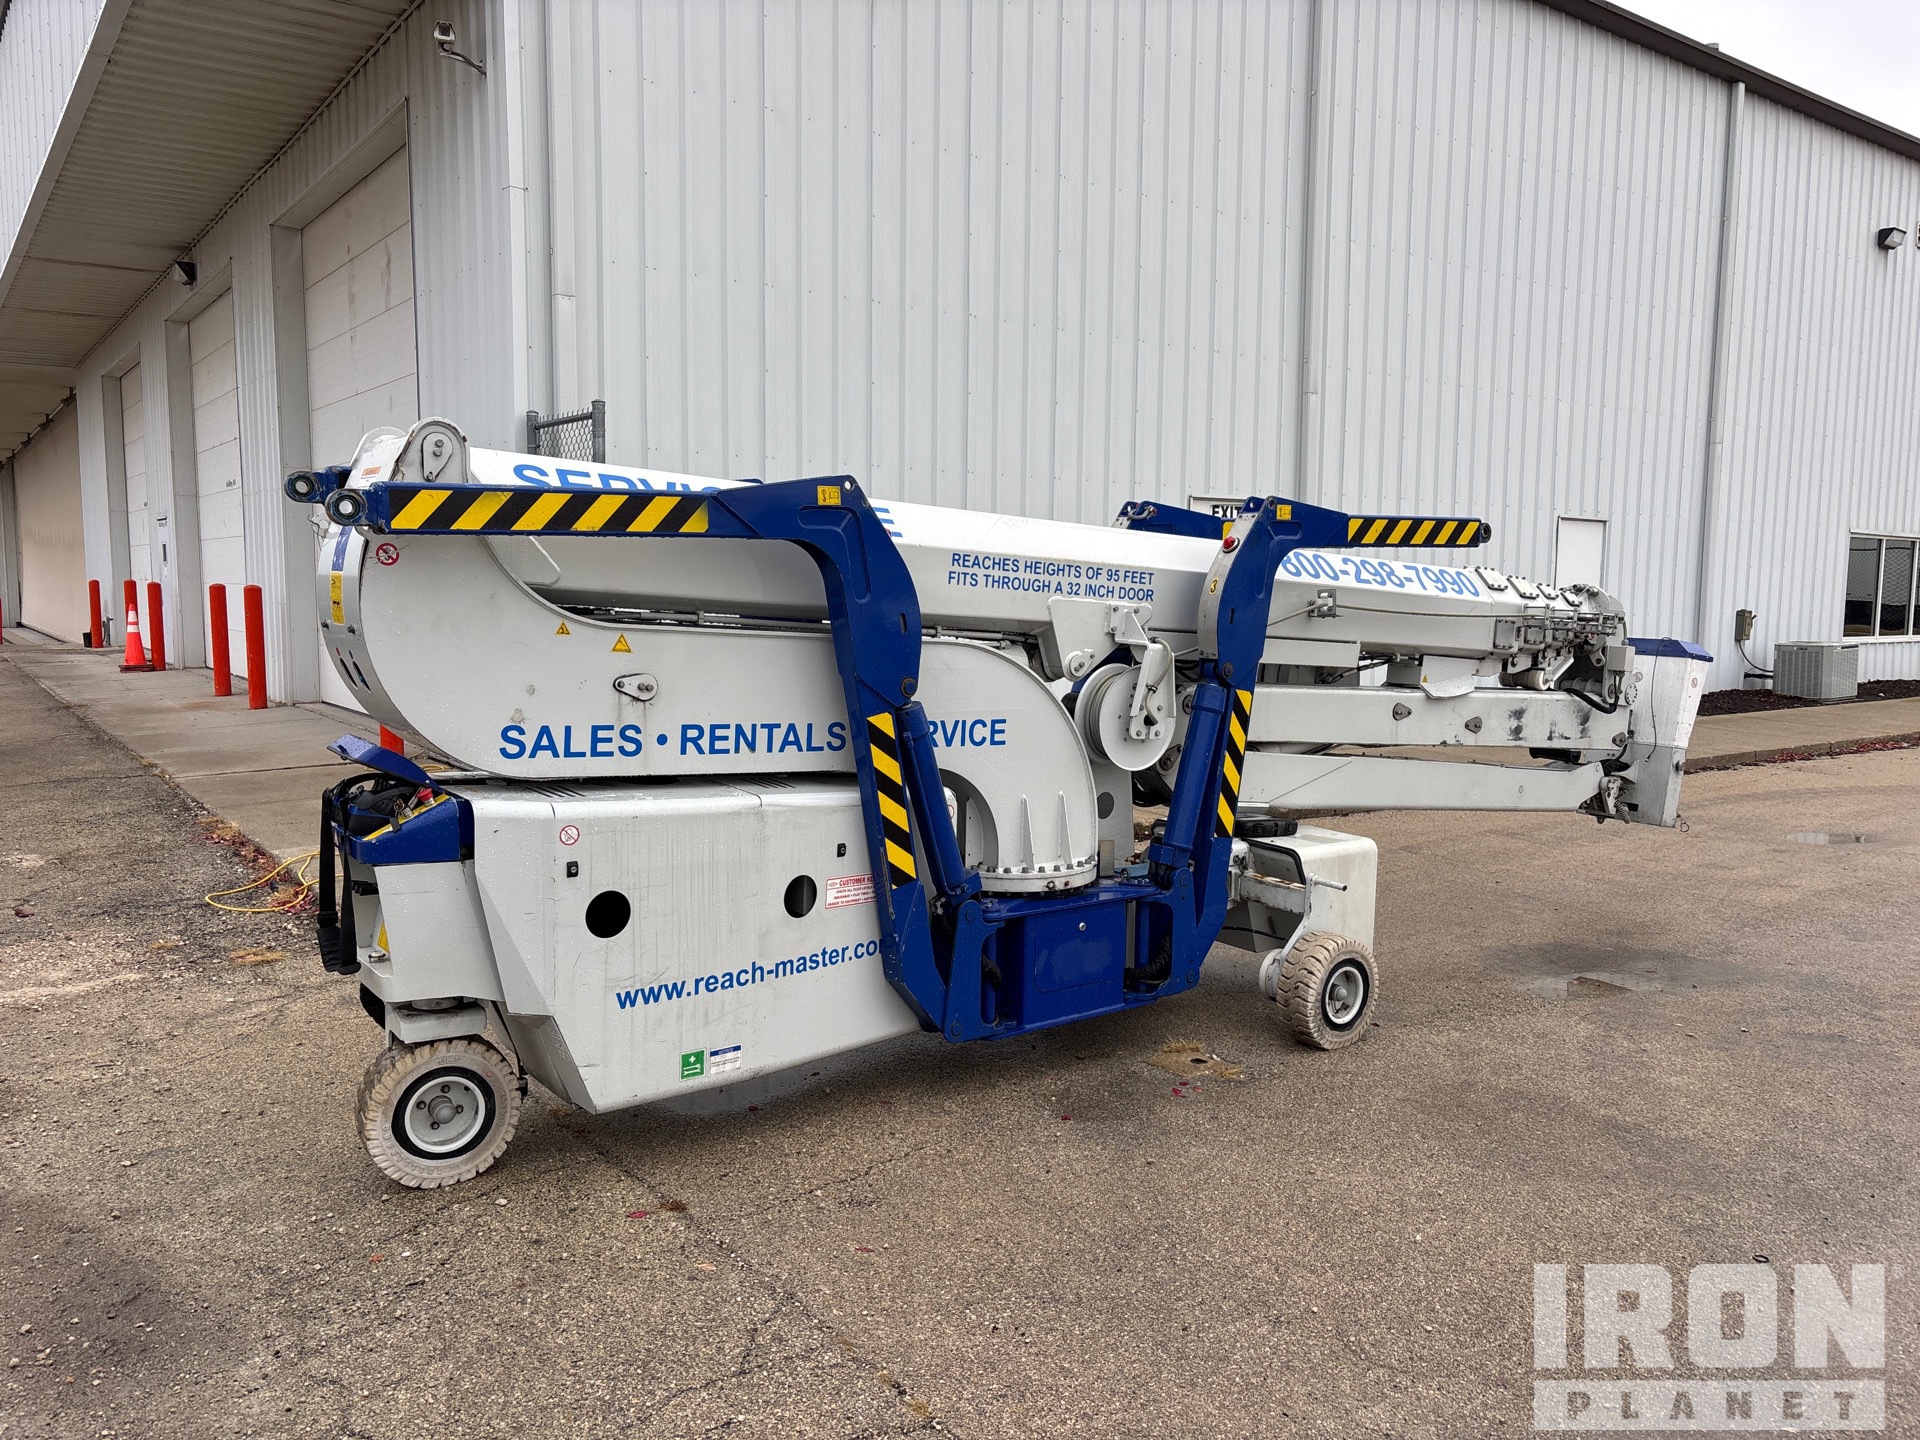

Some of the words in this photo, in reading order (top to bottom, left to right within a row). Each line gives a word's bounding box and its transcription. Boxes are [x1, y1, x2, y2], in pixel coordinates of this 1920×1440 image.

[952, 553, 1019, 573] REACHES
[1024, 560, 1081, 578] HEIGHTS
[1086, 566, 1103, 580] OF
[1107, 568, 1120, 582] 95
[1124, 570, 1155, 585] FEET
[948, 571, 978, 586] FITS
[983, 574, 1050, 593] THROUGH
[1054, 580, 1064, 594] A
[1067, 582, 1081, 596] 32
[1085, 584, 1114, 598] INCH
[1119, 586, 1154, 601] DOOR
[1210, 579, 1218, 593] 3
[499, 723, 643, 759] SALES
[679, 721, 847, 756] RENTALS
[928, 718, 1007, 748] RVICE
[839, 876, 865, 887] CUSTOMER
[616, 939, 883, 1010] www.reach-master.co
